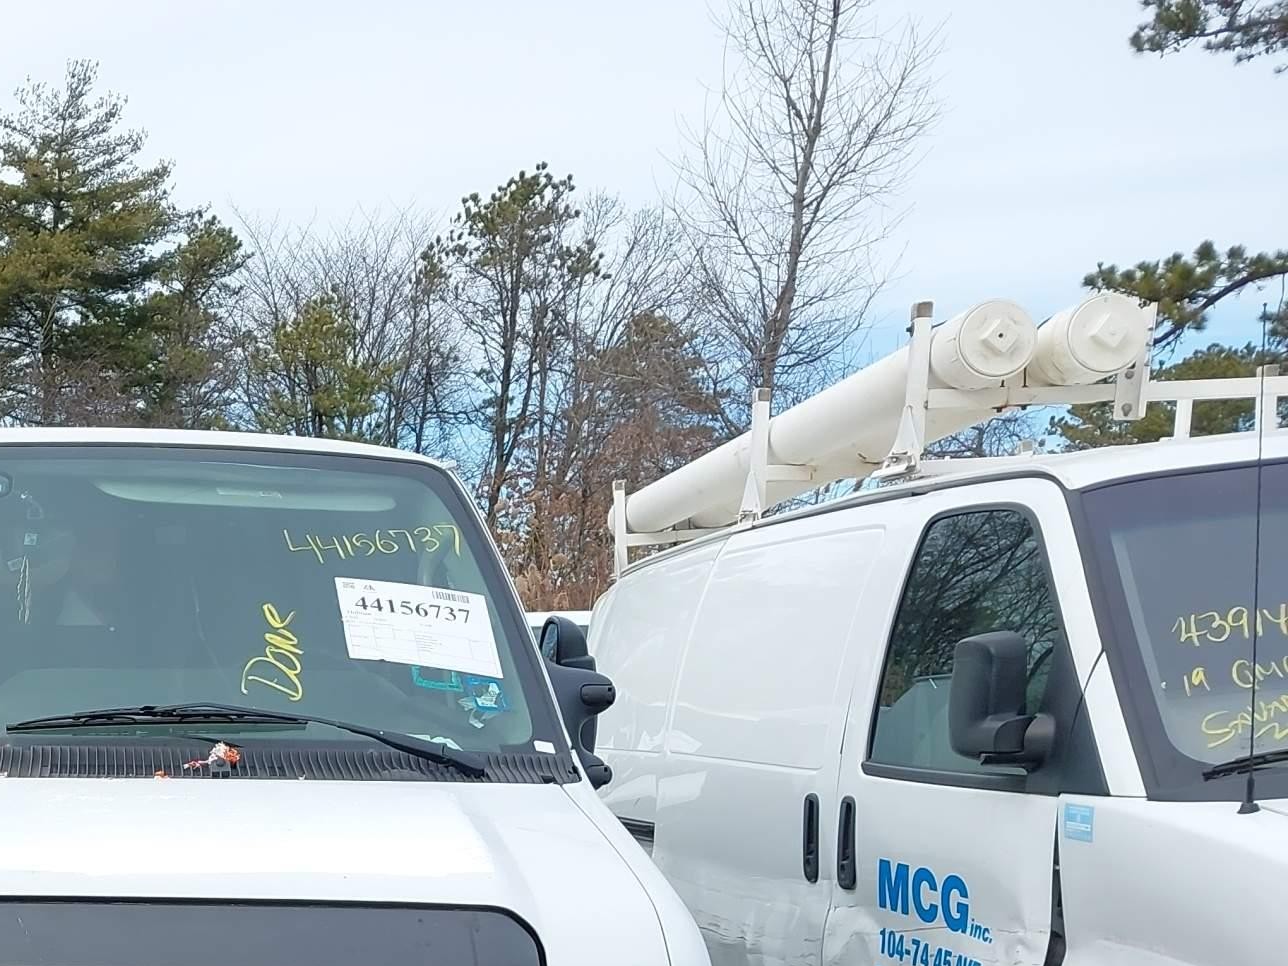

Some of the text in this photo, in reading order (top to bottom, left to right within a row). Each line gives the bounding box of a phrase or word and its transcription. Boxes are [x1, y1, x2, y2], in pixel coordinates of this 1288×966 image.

[283, 524, 462, 564] 44156737
[354, 596, 471, 624] 44156737
[877, 857, 970, 935] MCG
